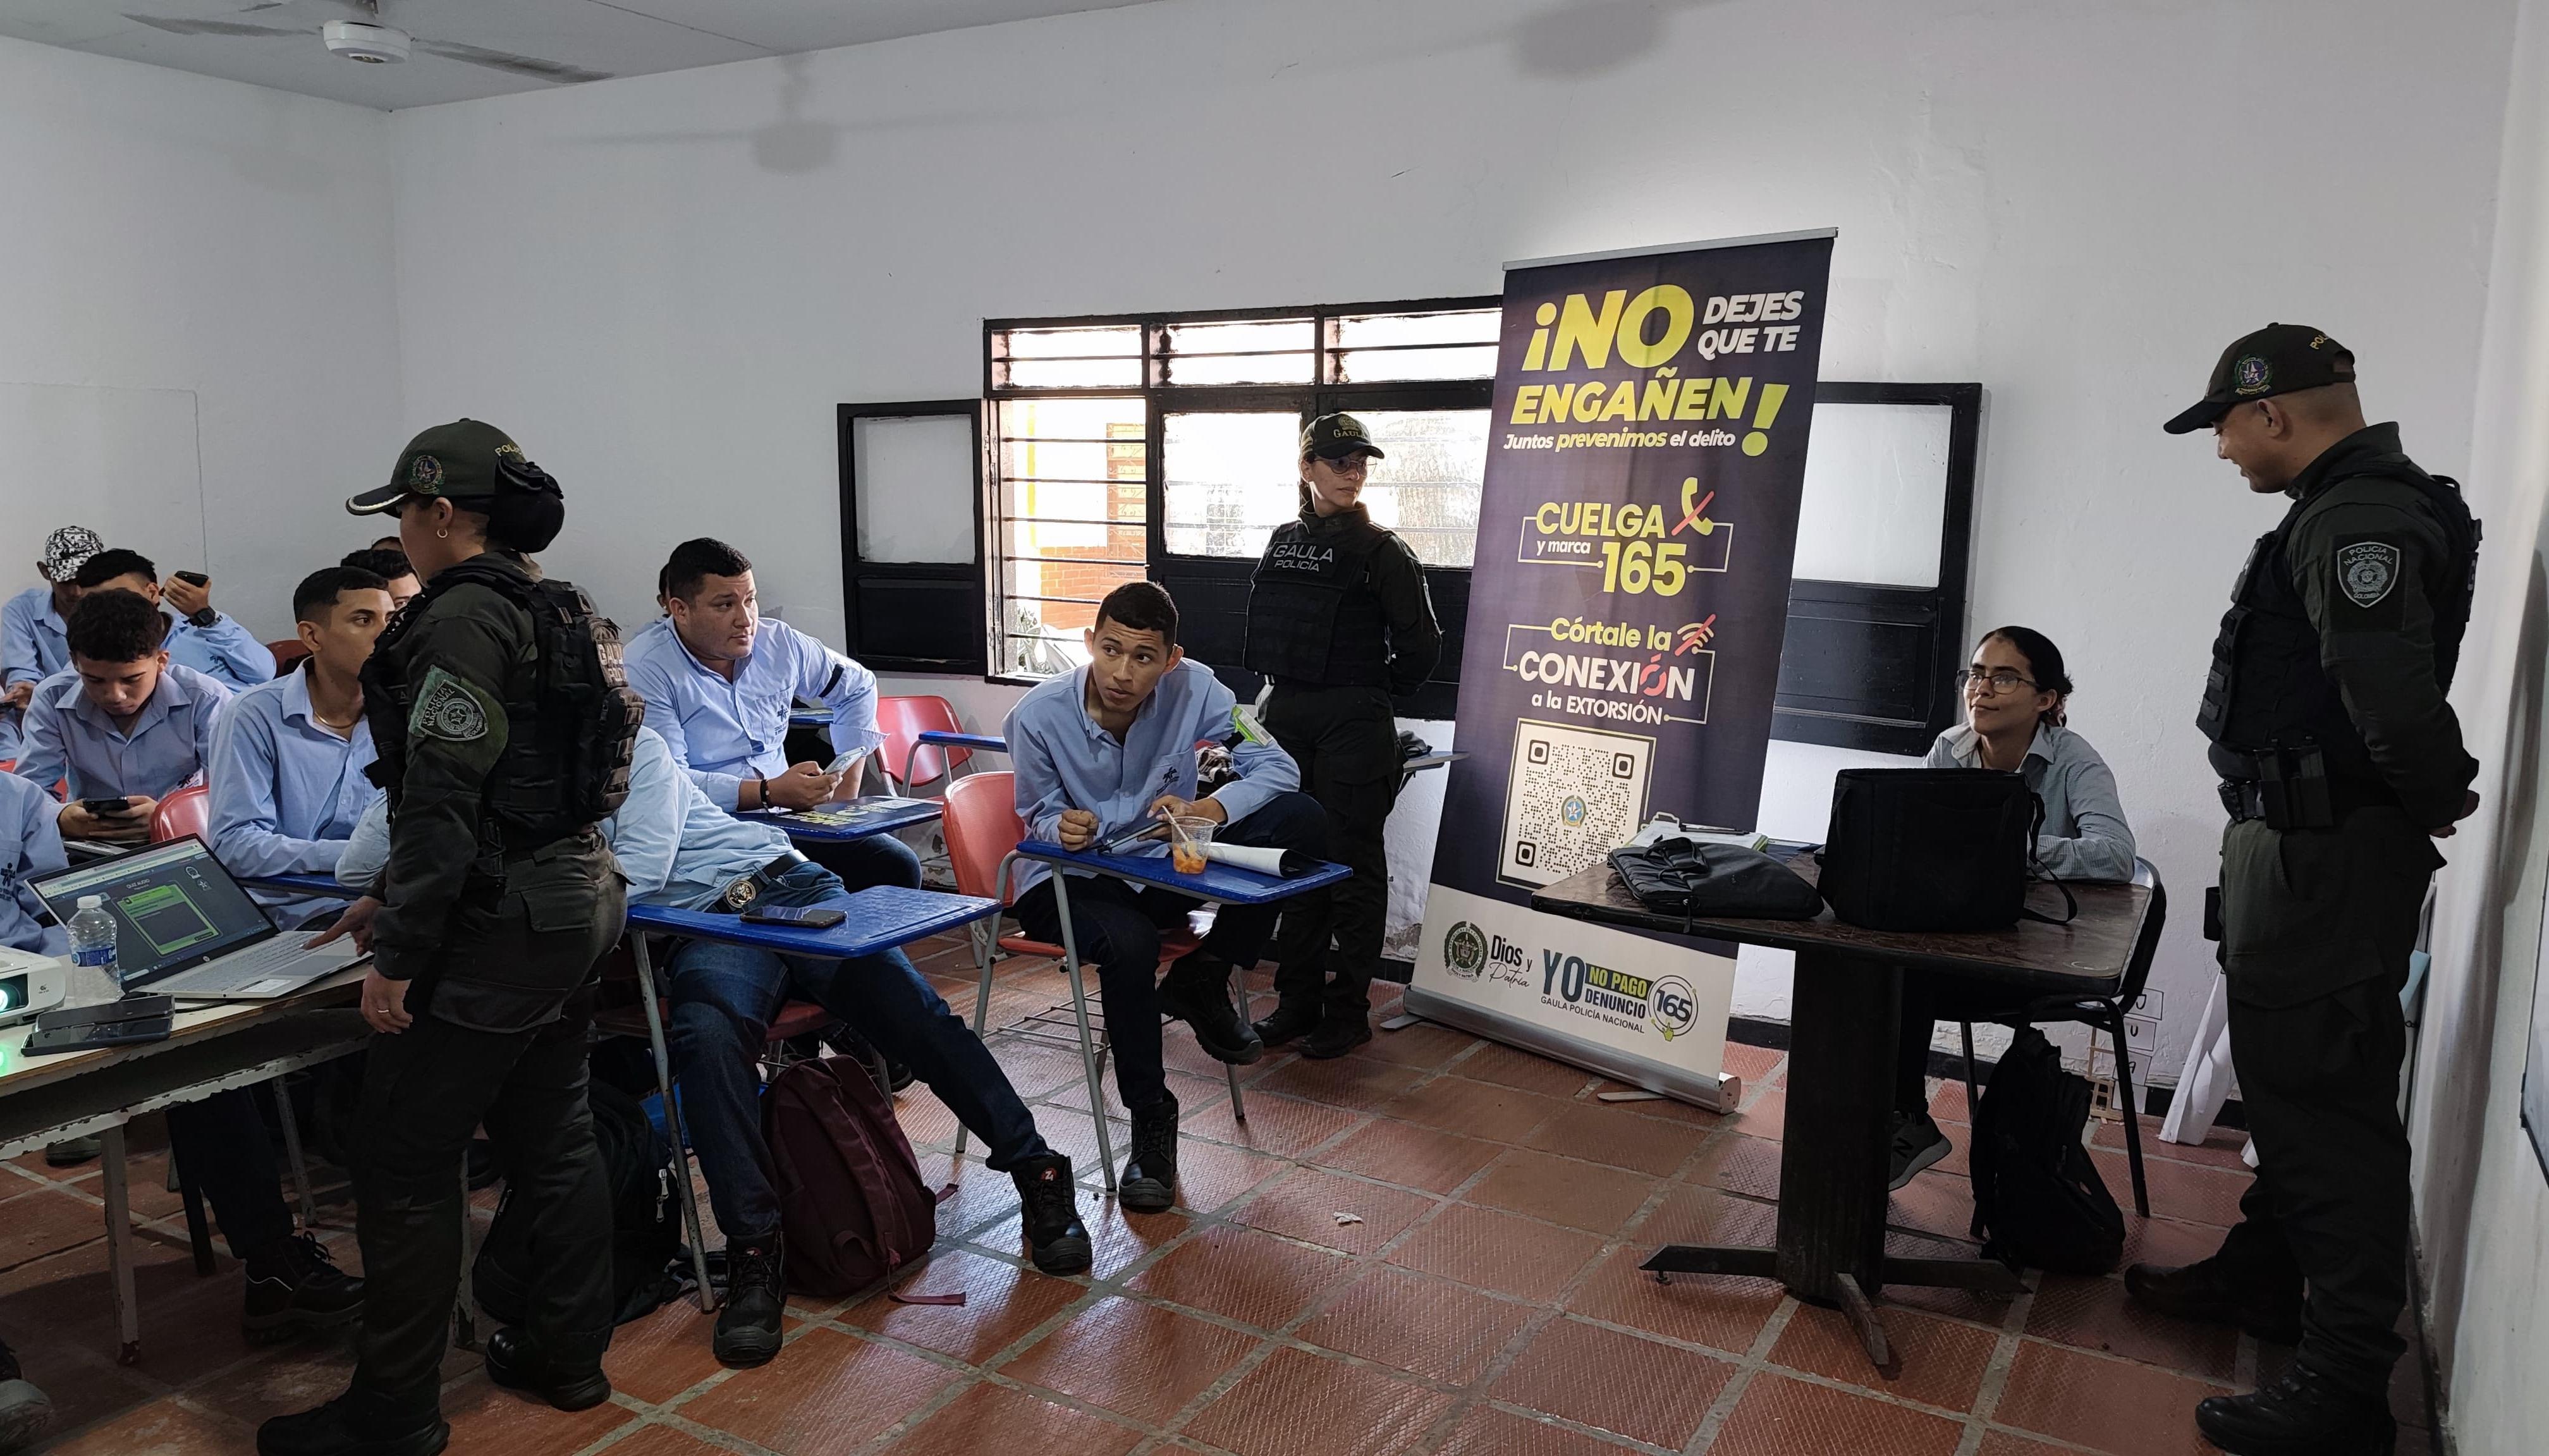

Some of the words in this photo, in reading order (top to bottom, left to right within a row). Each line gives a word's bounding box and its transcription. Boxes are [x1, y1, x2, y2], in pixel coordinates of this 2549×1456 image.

[1702, 291, 1804, 324] DEJES
[1522, 284, 1694, 371] ¡NO
[1697, 328, 1757, 360] QUE
[1763, 324, 1800, 352] TE
[1503, 434, 1553, 450] Juntos
[1555, 427, 1667, 452] prevenimos
[1670, 430, 1685, 447] el
[1689, 428, 1736, 447] delito
[1536, 502, 1666, 539] CUELGA
[1273, 544, 1333, 563] GAULA
[1536, 541, 1545, 556] y
[1548, 539, 1591, 554] marca
[2344, 553, 2393, 566] NACIONAL
[1274, 560, 1319, 572] POLICÍA
[1601, 541, 1687, 597] 165
[1550, 616, 1641, 649] Córtale
[1646, 625, 1672, 651] la
[1519, 651, 1695, 701] CONEXIÓN
[427, 688, 455, 726] NACIONAL
[1531, 694, 1543, 707] a
[1546, 690, 1562, 709] la
[1566, 699, 1663, 725] EXTORSIÓN
[1491, 934, 1523, 967] Dios
[1526, 958, 1532, 972] y
[1489, 962, 1530, 988] Patria
[1543, 948, 1586, 1003] YO
[1589, 965, 1608, 987] NO
[1611, 972, 1647, 998] PAGO
[1541, 996, 1568, 1010] GAULA
[1569, 1004, 1601, 1021] POLICÍA
[1602, 1013, 1645, 1034] NACIONAL
[1584, 988, 1646, 1019] DENUNCIO
[1656, 989, 1692, 1022] 165
[2130, 1025, 2138, 1037] U
